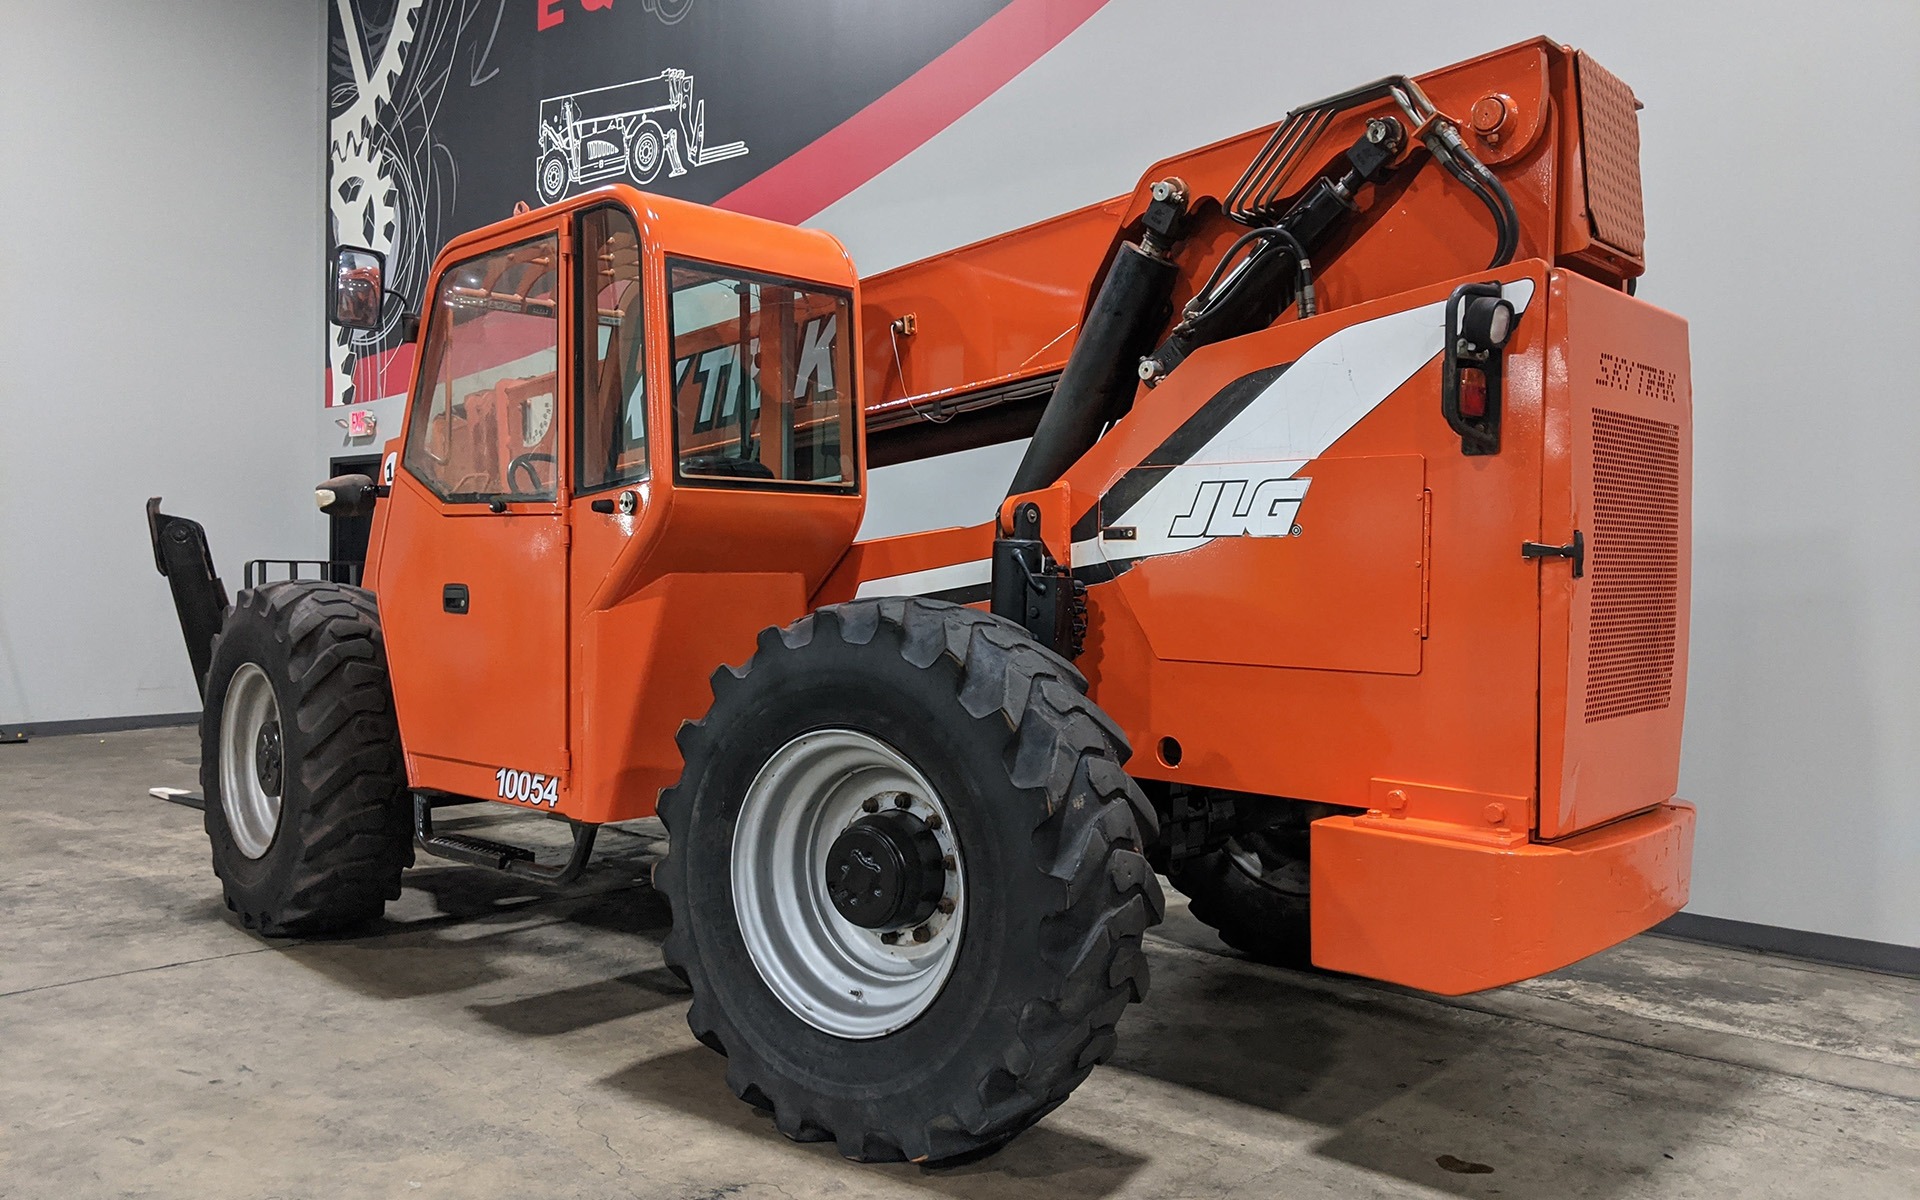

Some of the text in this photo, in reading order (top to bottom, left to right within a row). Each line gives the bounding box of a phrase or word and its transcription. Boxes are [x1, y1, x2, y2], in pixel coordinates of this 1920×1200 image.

[1596, 352, 1676, 403] SKYTRAK
[1167, 477, 1313, 538] JLG
[495, 767, 559, 808] 10054
